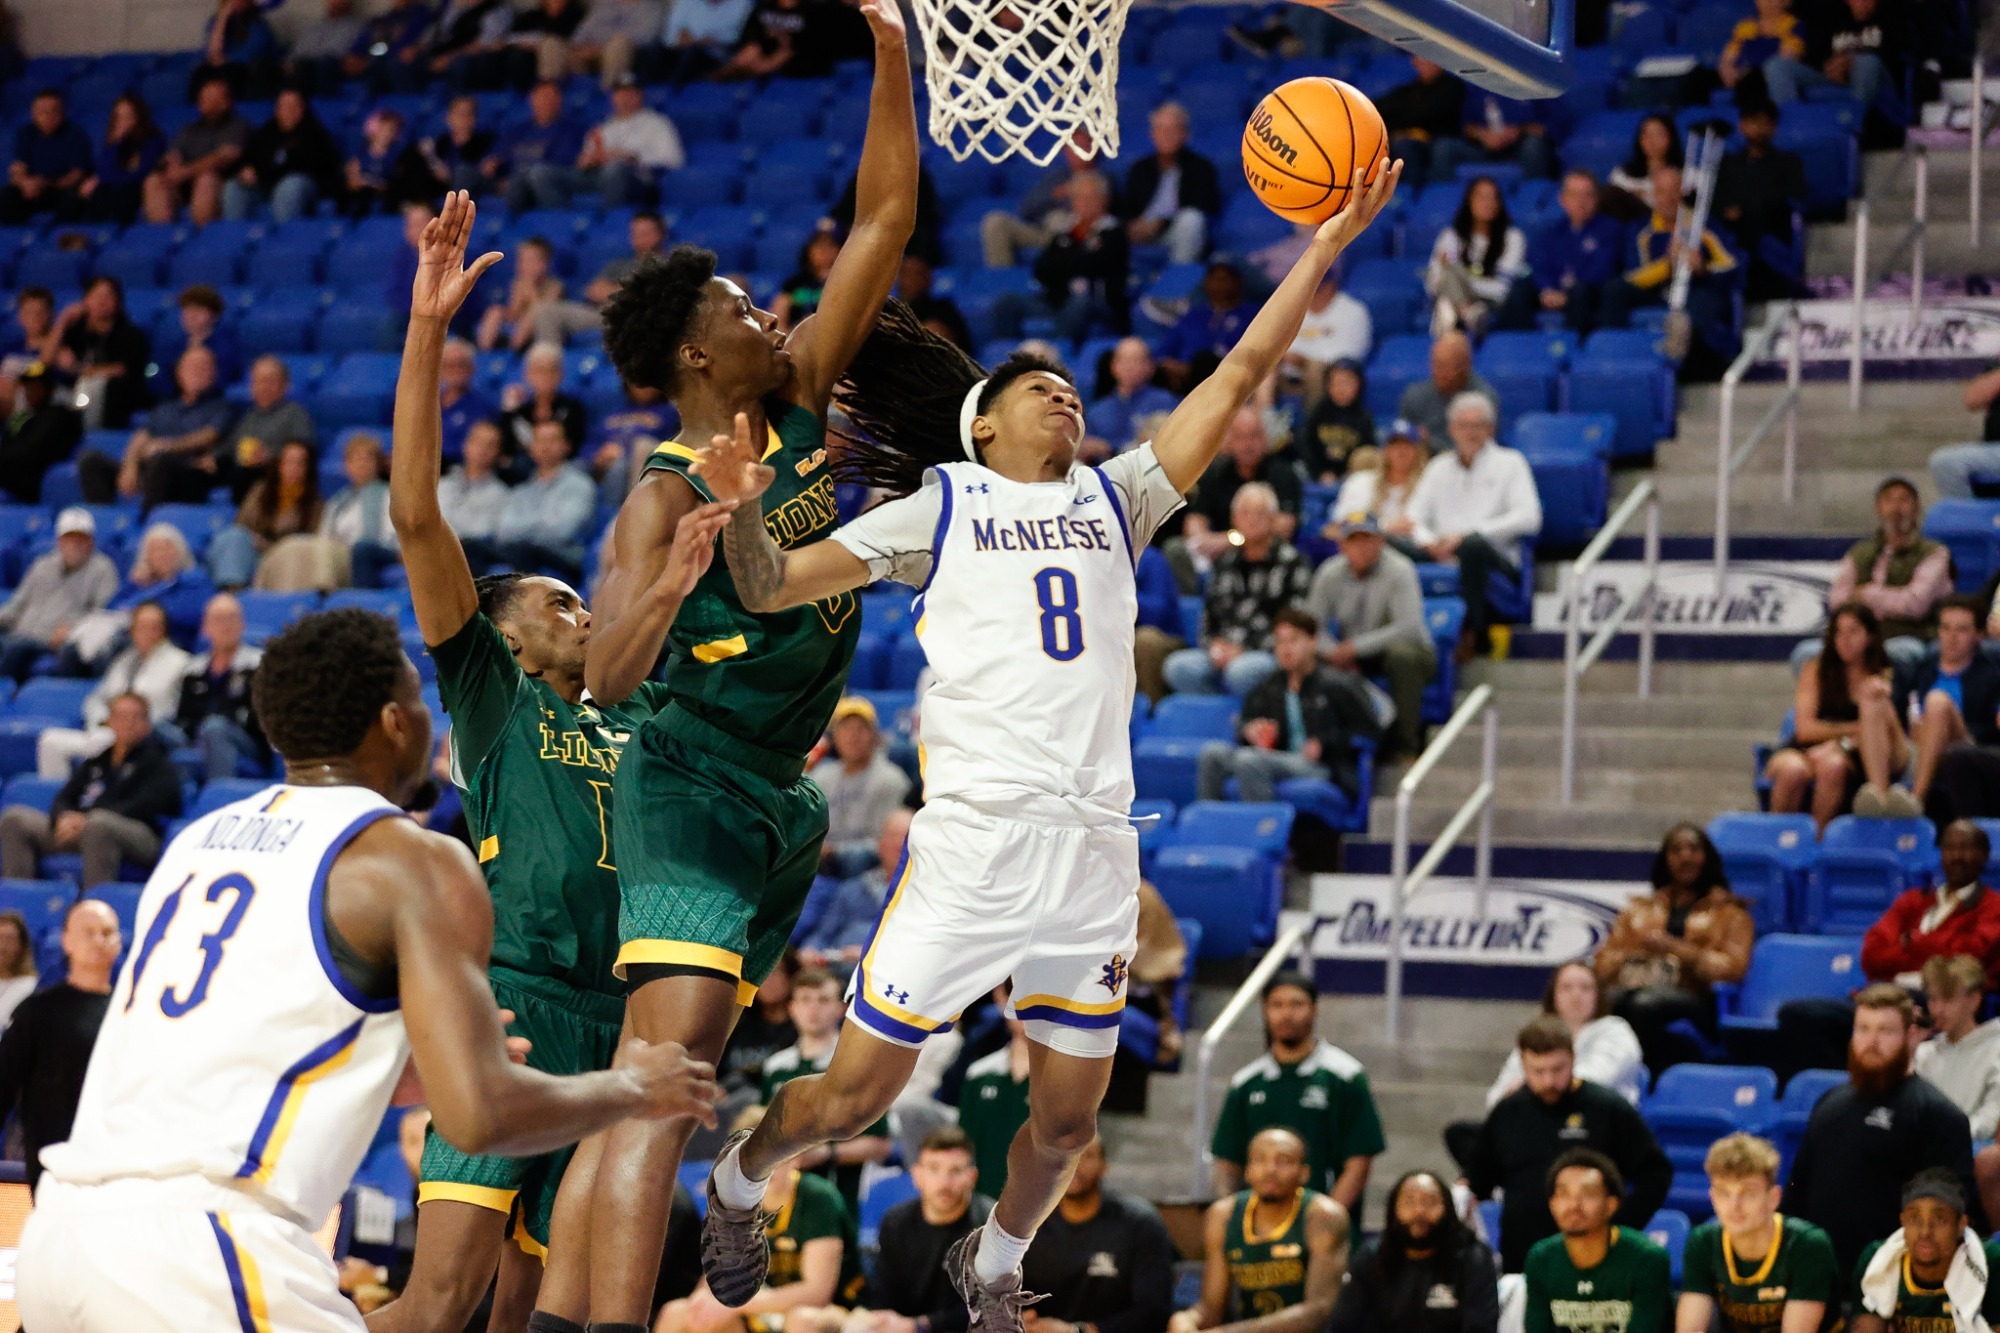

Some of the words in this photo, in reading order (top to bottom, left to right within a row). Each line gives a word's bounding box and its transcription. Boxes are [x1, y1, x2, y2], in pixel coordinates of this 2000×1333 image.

[1246, 164, 1268, 191] VO
[764, 473, 838, 551] IONS
[1033, 564, 1087, 664] 8
[124, 871, 257, 1019] 13
